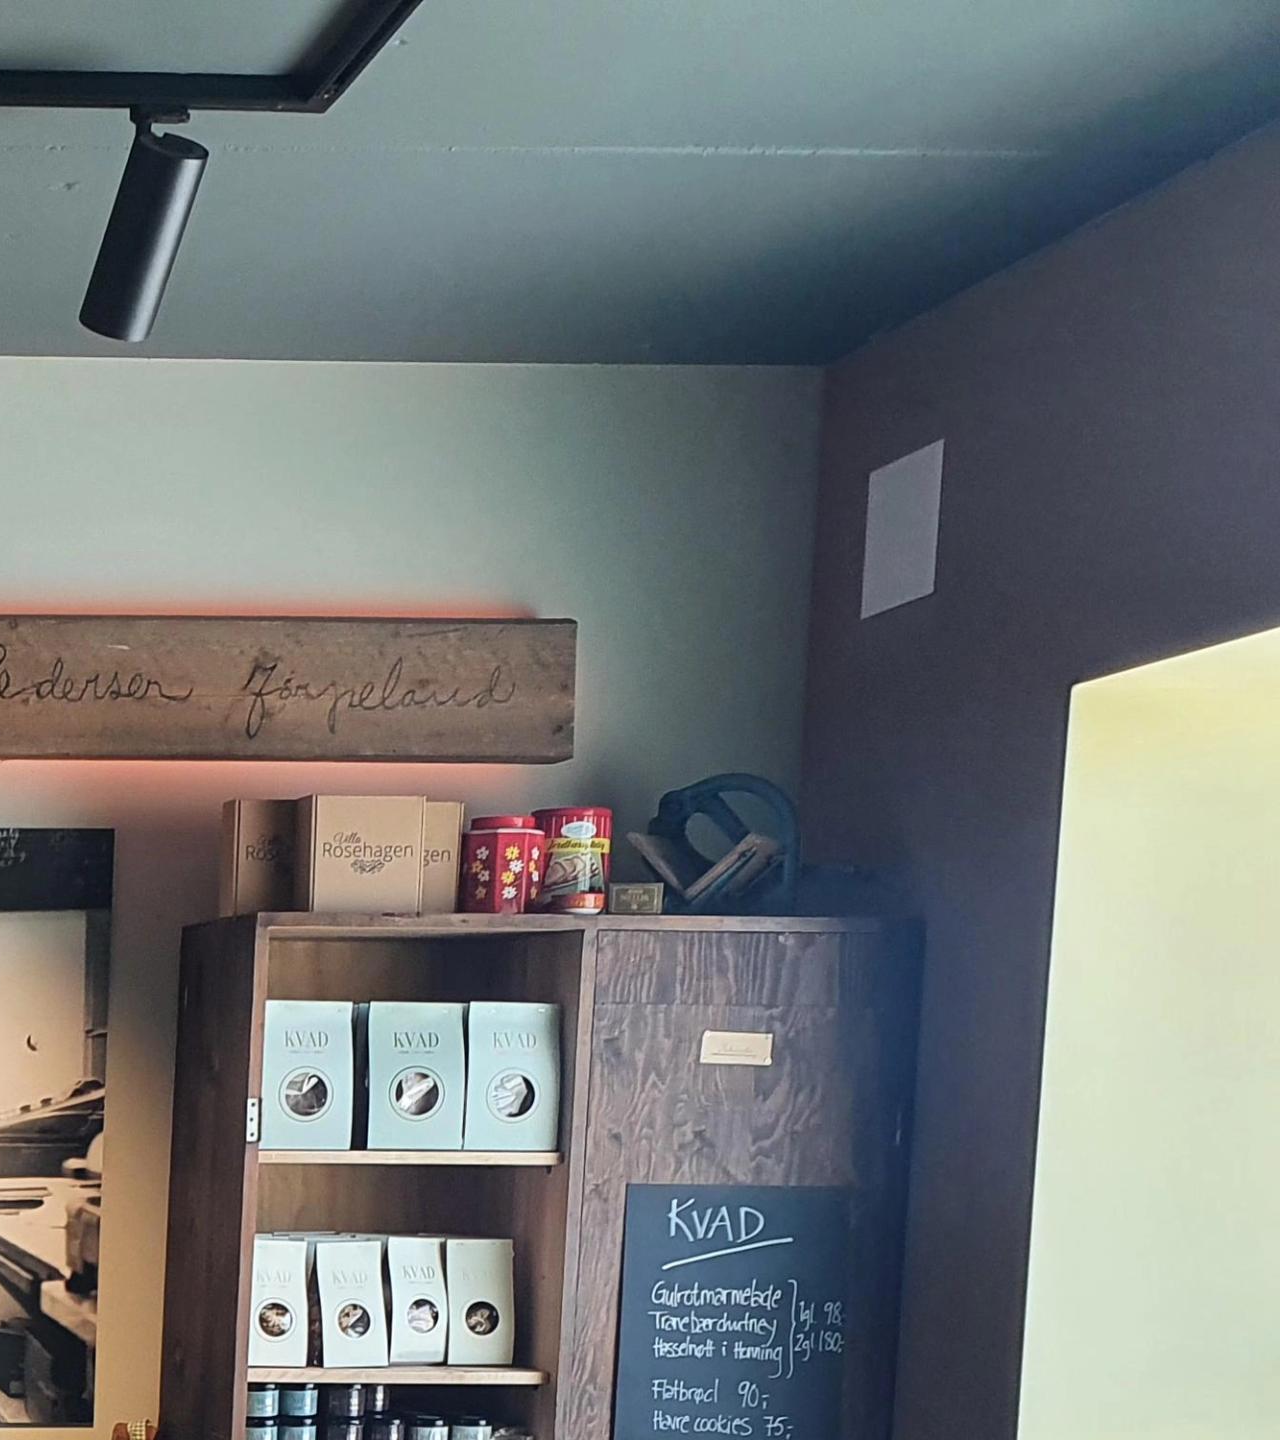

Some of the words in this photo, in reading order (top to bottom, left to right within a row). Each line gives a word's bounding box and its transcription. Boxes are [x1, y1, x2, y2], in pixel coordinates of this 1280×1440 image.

[322, 841, 414, 863] Rosehagen
[284, 1031, 329, 1049] KVAD
[393, 1032, 439, 1049] KVAD
[492, 1031, 537, 1049] KVAD
[666, 1198, 766, 1243] KVAD
[402, 1265, 435, 1280] KVAD
[721, 1341, 728, 1357] i
[651, 1378, 719, 1405] Flatbrød
[653, 1410, 690, 1434] Havre
[693, 1414, 753, 1437] cookies
